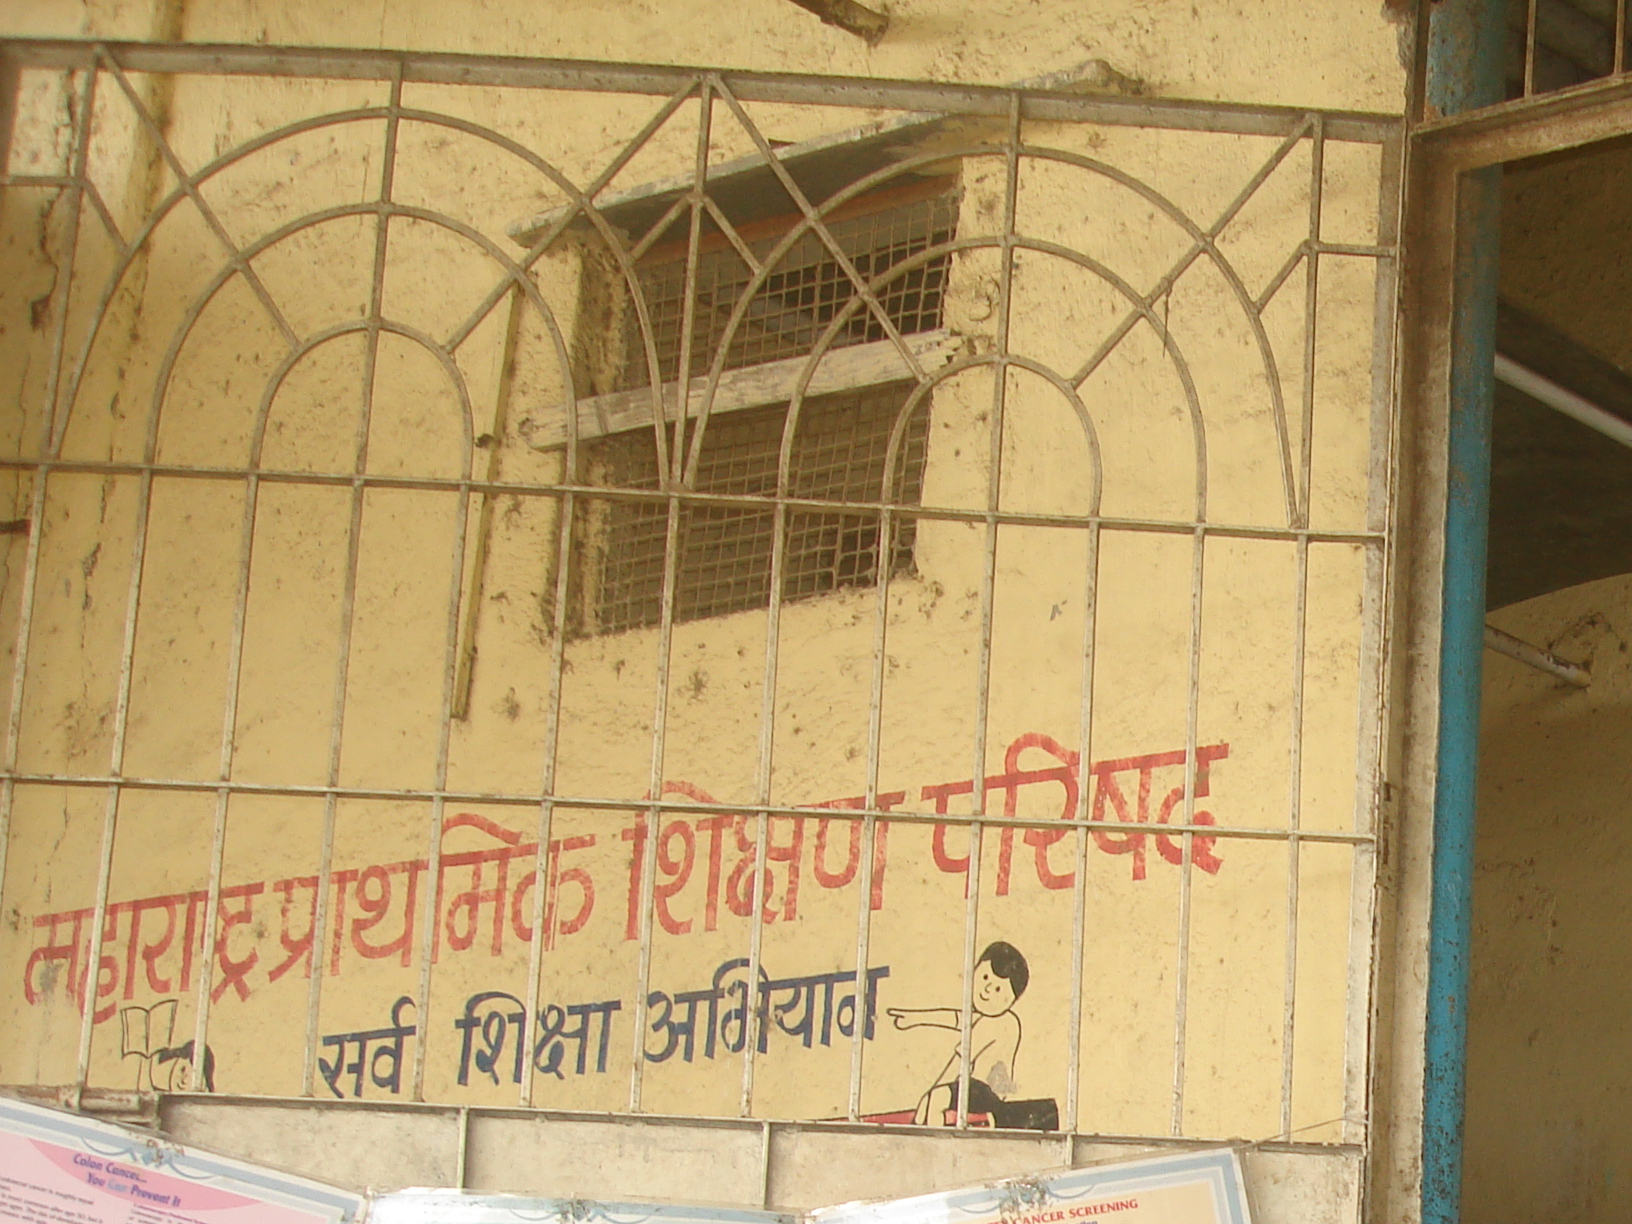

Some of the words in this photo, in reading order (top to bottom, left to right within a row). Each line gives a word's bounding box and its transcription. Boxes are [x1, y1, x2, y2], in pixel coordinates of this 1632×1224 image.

[268, 812, 596, 983] प्राथमिक
[622, 781, 904, 941] शिक्षण
[318, 995, 417, 1098] सर्व
[455, 991, 621, 1087] शिक्षा
[644, 957, 889, 1063] अभियान
[73, 1153, 103, 1170] Colon
[88, 1172, 105, 1186] You
[131, 1184, 172, 1204] Prevent
[1069, 1199, 1138, 1218] SCREENING
